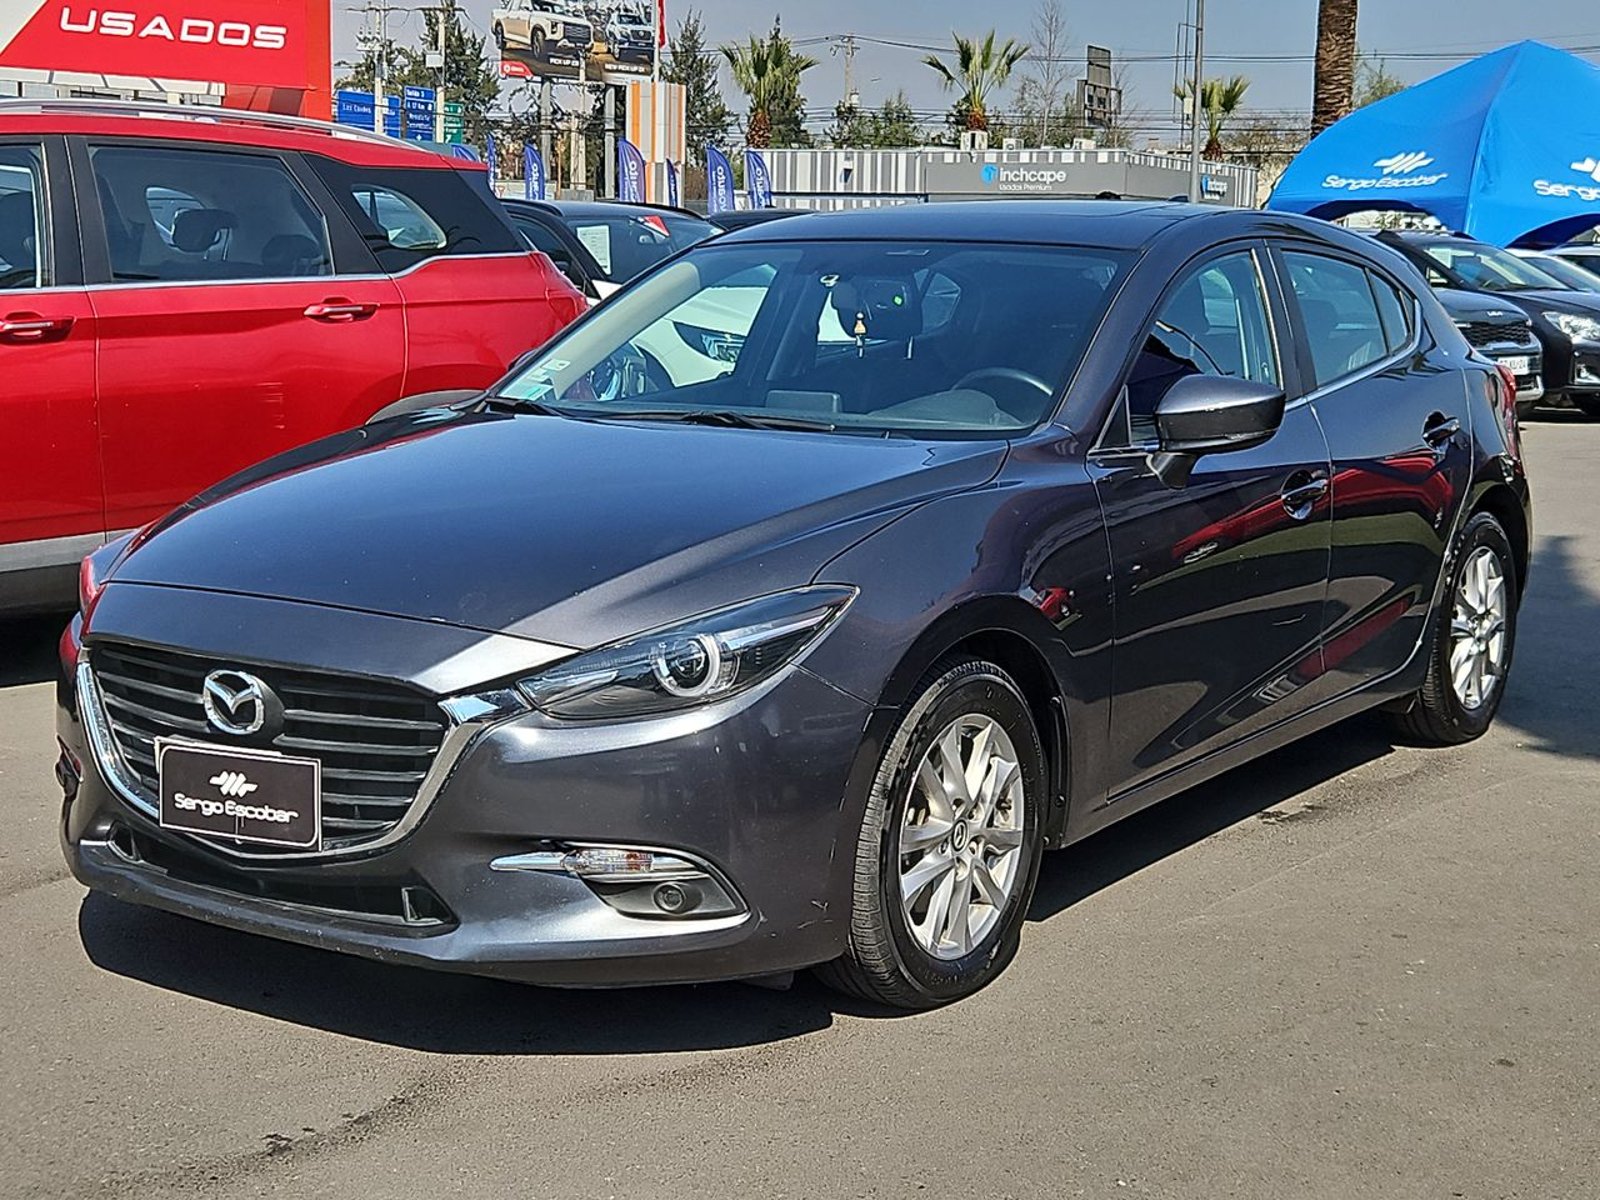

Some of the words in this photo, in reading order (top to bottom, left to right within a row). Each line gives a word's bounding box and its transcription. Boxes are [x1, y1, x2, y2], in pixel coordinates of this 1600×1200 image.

[59, 6, 287, 49] USADOS
[999, 167, 1067, 185] inchcape
[1321, 174, 1376, 191] Sergo
[1374, 172, 1448, 188] Escobar
[173, 792, 224, 816] Sergo
[224, 799, 299, 823] Escobar
